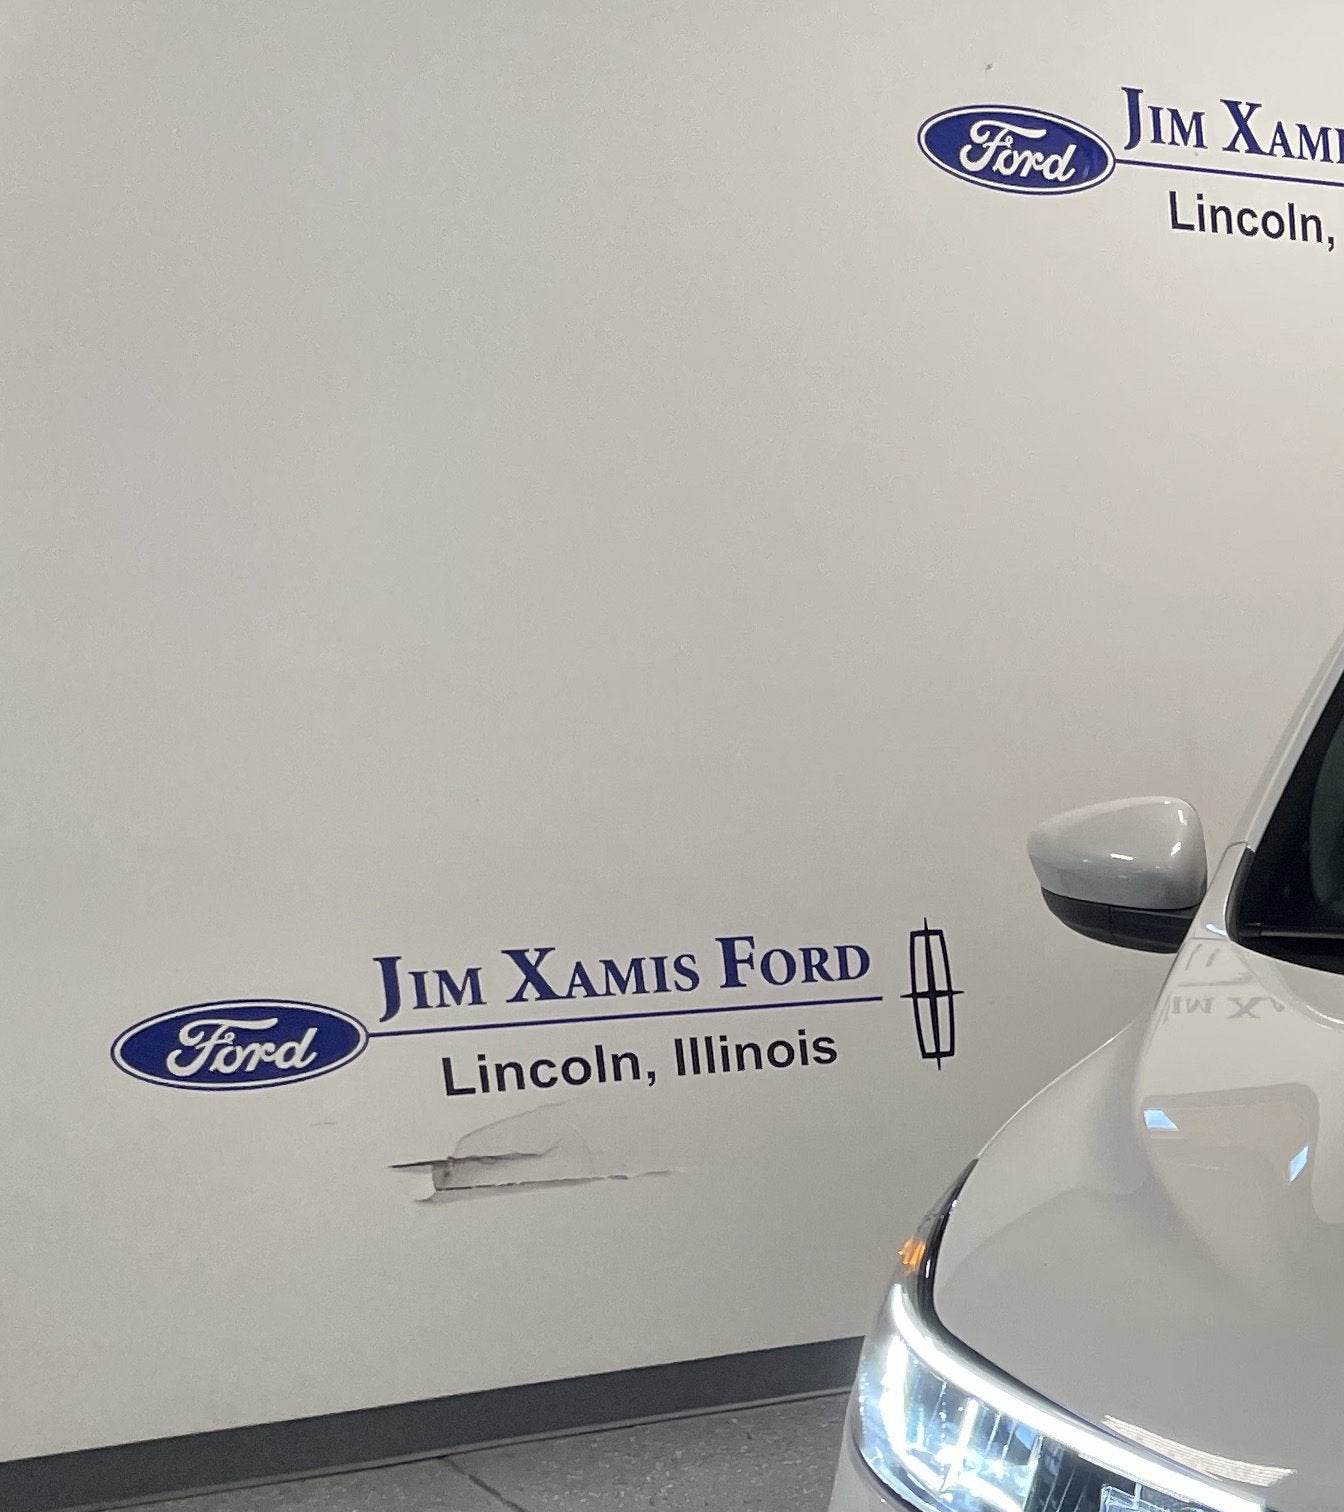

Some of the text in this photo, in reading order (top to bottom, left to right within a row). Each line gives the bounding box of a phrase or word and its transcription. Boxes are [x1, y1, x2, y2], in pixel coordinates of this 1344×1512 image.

[960, 120, 1076, 181] Ford
[1170, 191, 1334, 251] Lincoln,
[167, 1018, 317, 1076] Ford
[442, 1029, 837, 1096] Lincoln, Illinois
